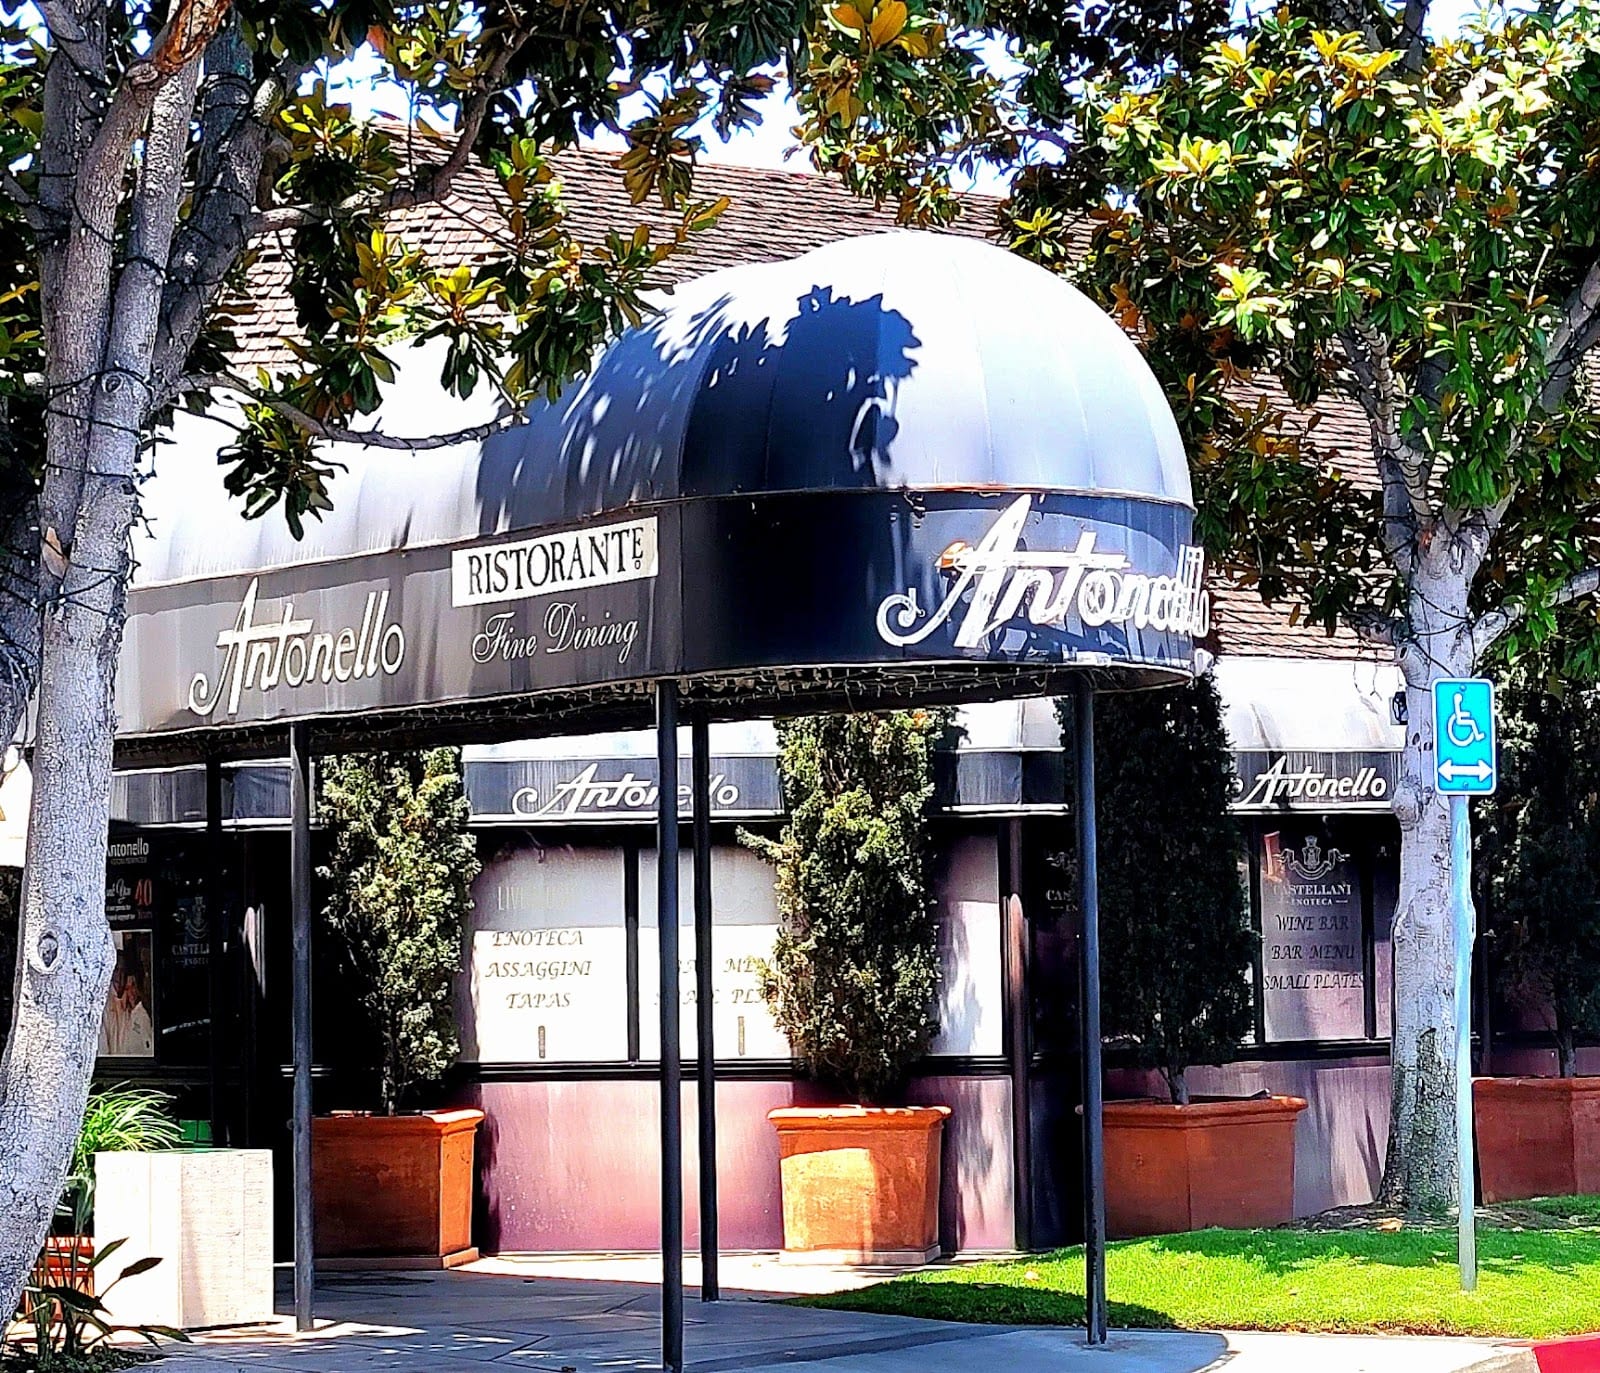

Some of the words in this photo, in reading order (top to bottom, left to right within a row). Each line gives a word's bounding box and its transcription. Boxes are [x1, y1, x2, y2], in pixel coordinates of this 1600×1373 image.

[468, 526, 644, 596] RISTORANTE
[876, 493, 1210, 648] Antonello
[472, 611, 537, 665] Fine
[543, 601, 638, 665] Dining
[188, 576, 404, 716] Antonello
[1226, 754, 1387, 807] Antonello
[107, 837, 149, 857] ntonello
[1273, 884, 1351, 896] CASTELLANI
[1276, 914, 1315, 931] WINE
[1318, 915, 1349, 931] BAR
[492, 930, 583, 947] ENOTECA
[1271, 945, 1303, 960] BAR
[1308, 944, 1355, 960] MENU
[484, 960, 592, 980] ASSAGGINI
[1263, 974, 1311, 990] SMALL
[505, 992, 571, 1009] TAPAS
